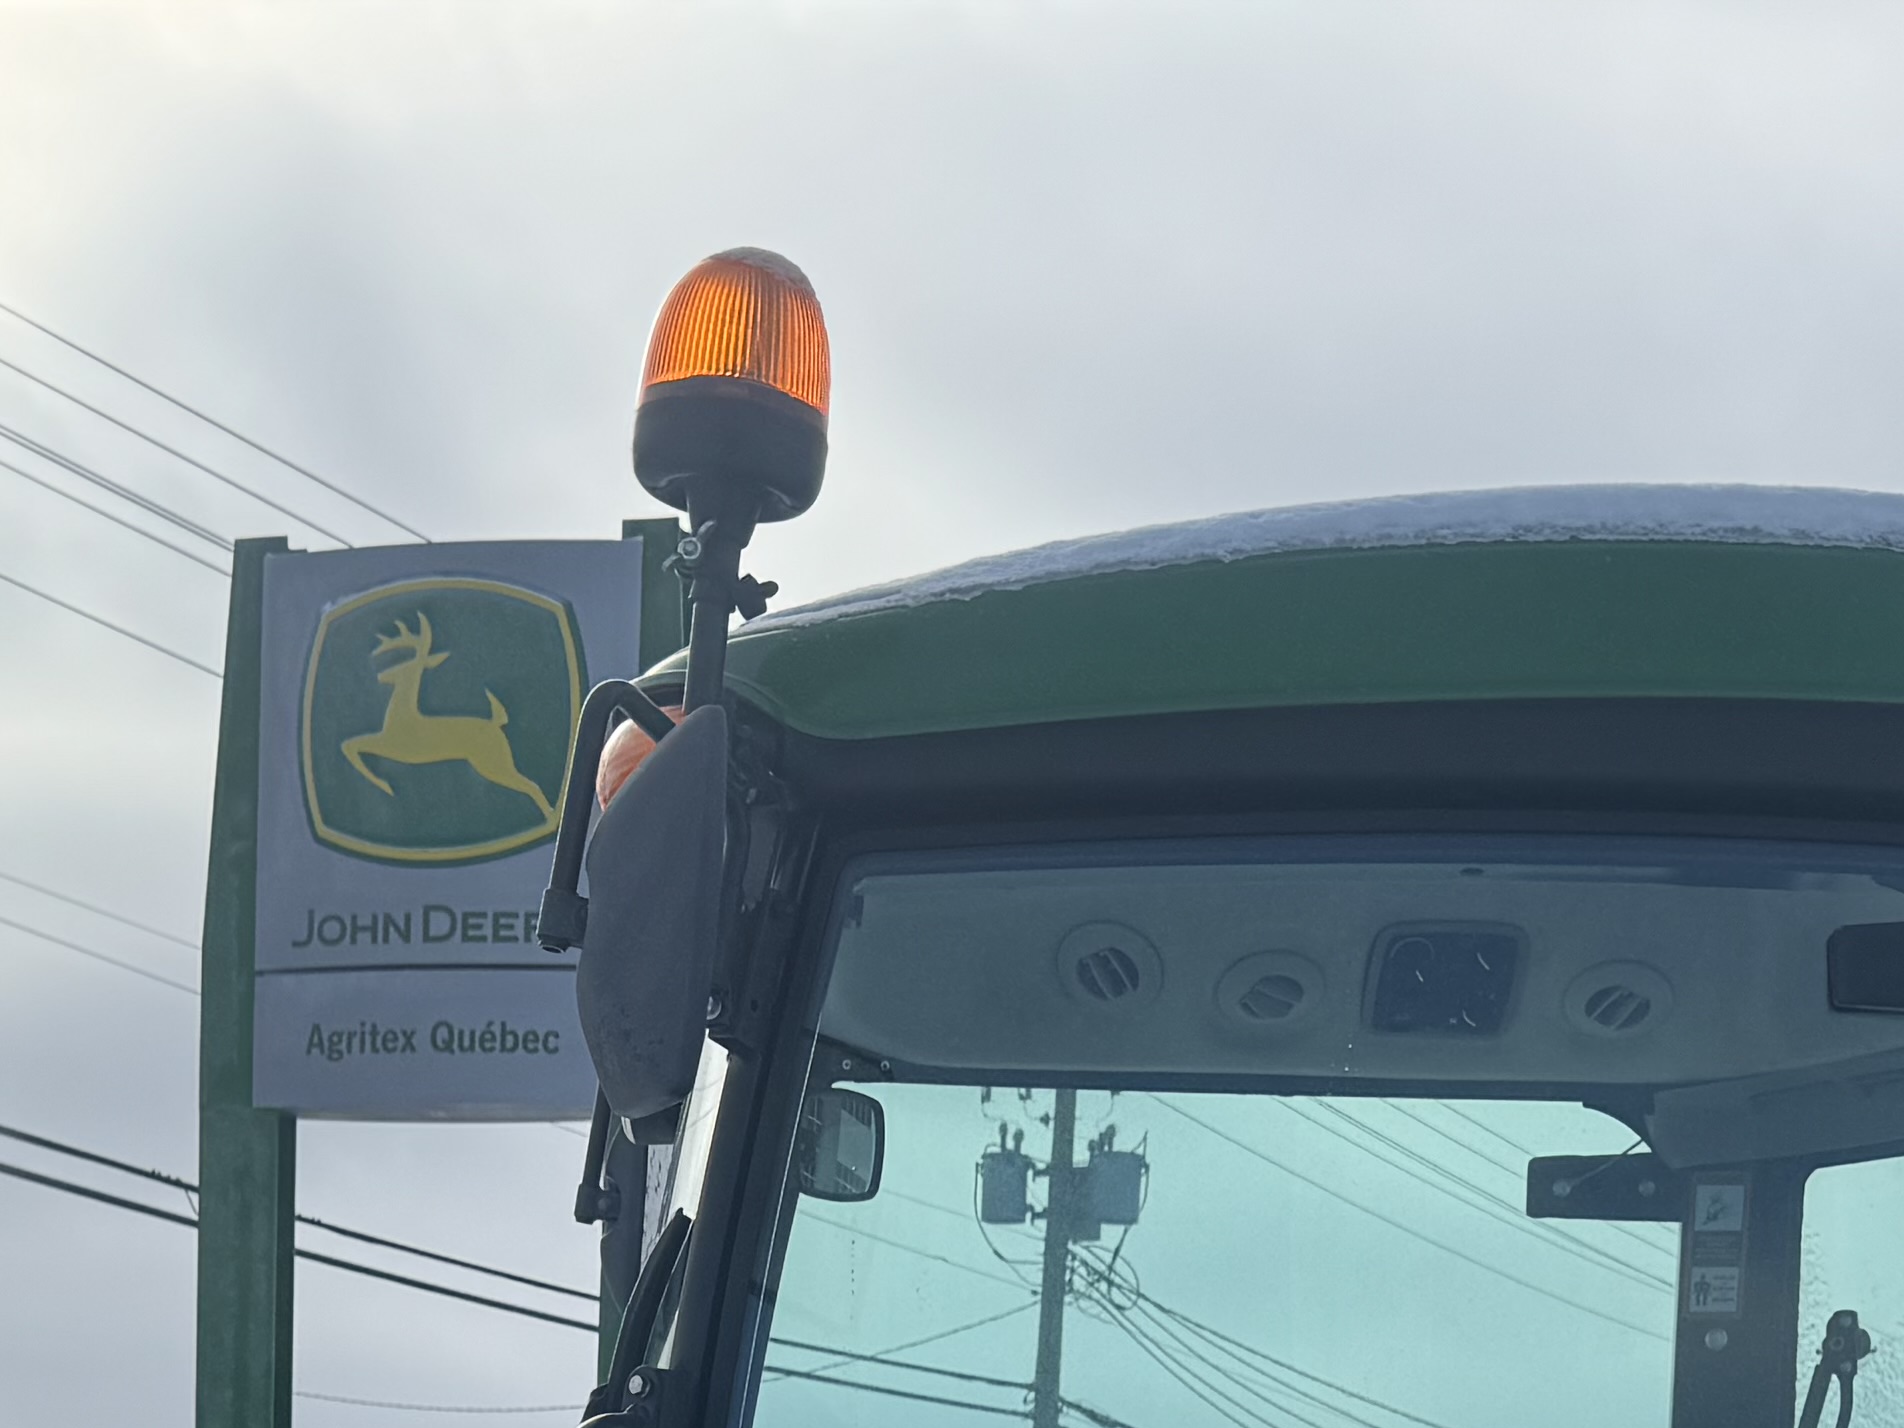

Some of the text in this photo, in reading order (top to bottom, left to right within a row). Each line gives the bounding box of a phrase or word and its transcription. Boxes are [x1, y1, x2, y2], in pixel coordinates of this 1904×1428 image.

[292, 905, 538, 948] JOHN DEE
[306, 1020, 560, 1062] Agritex Québec
